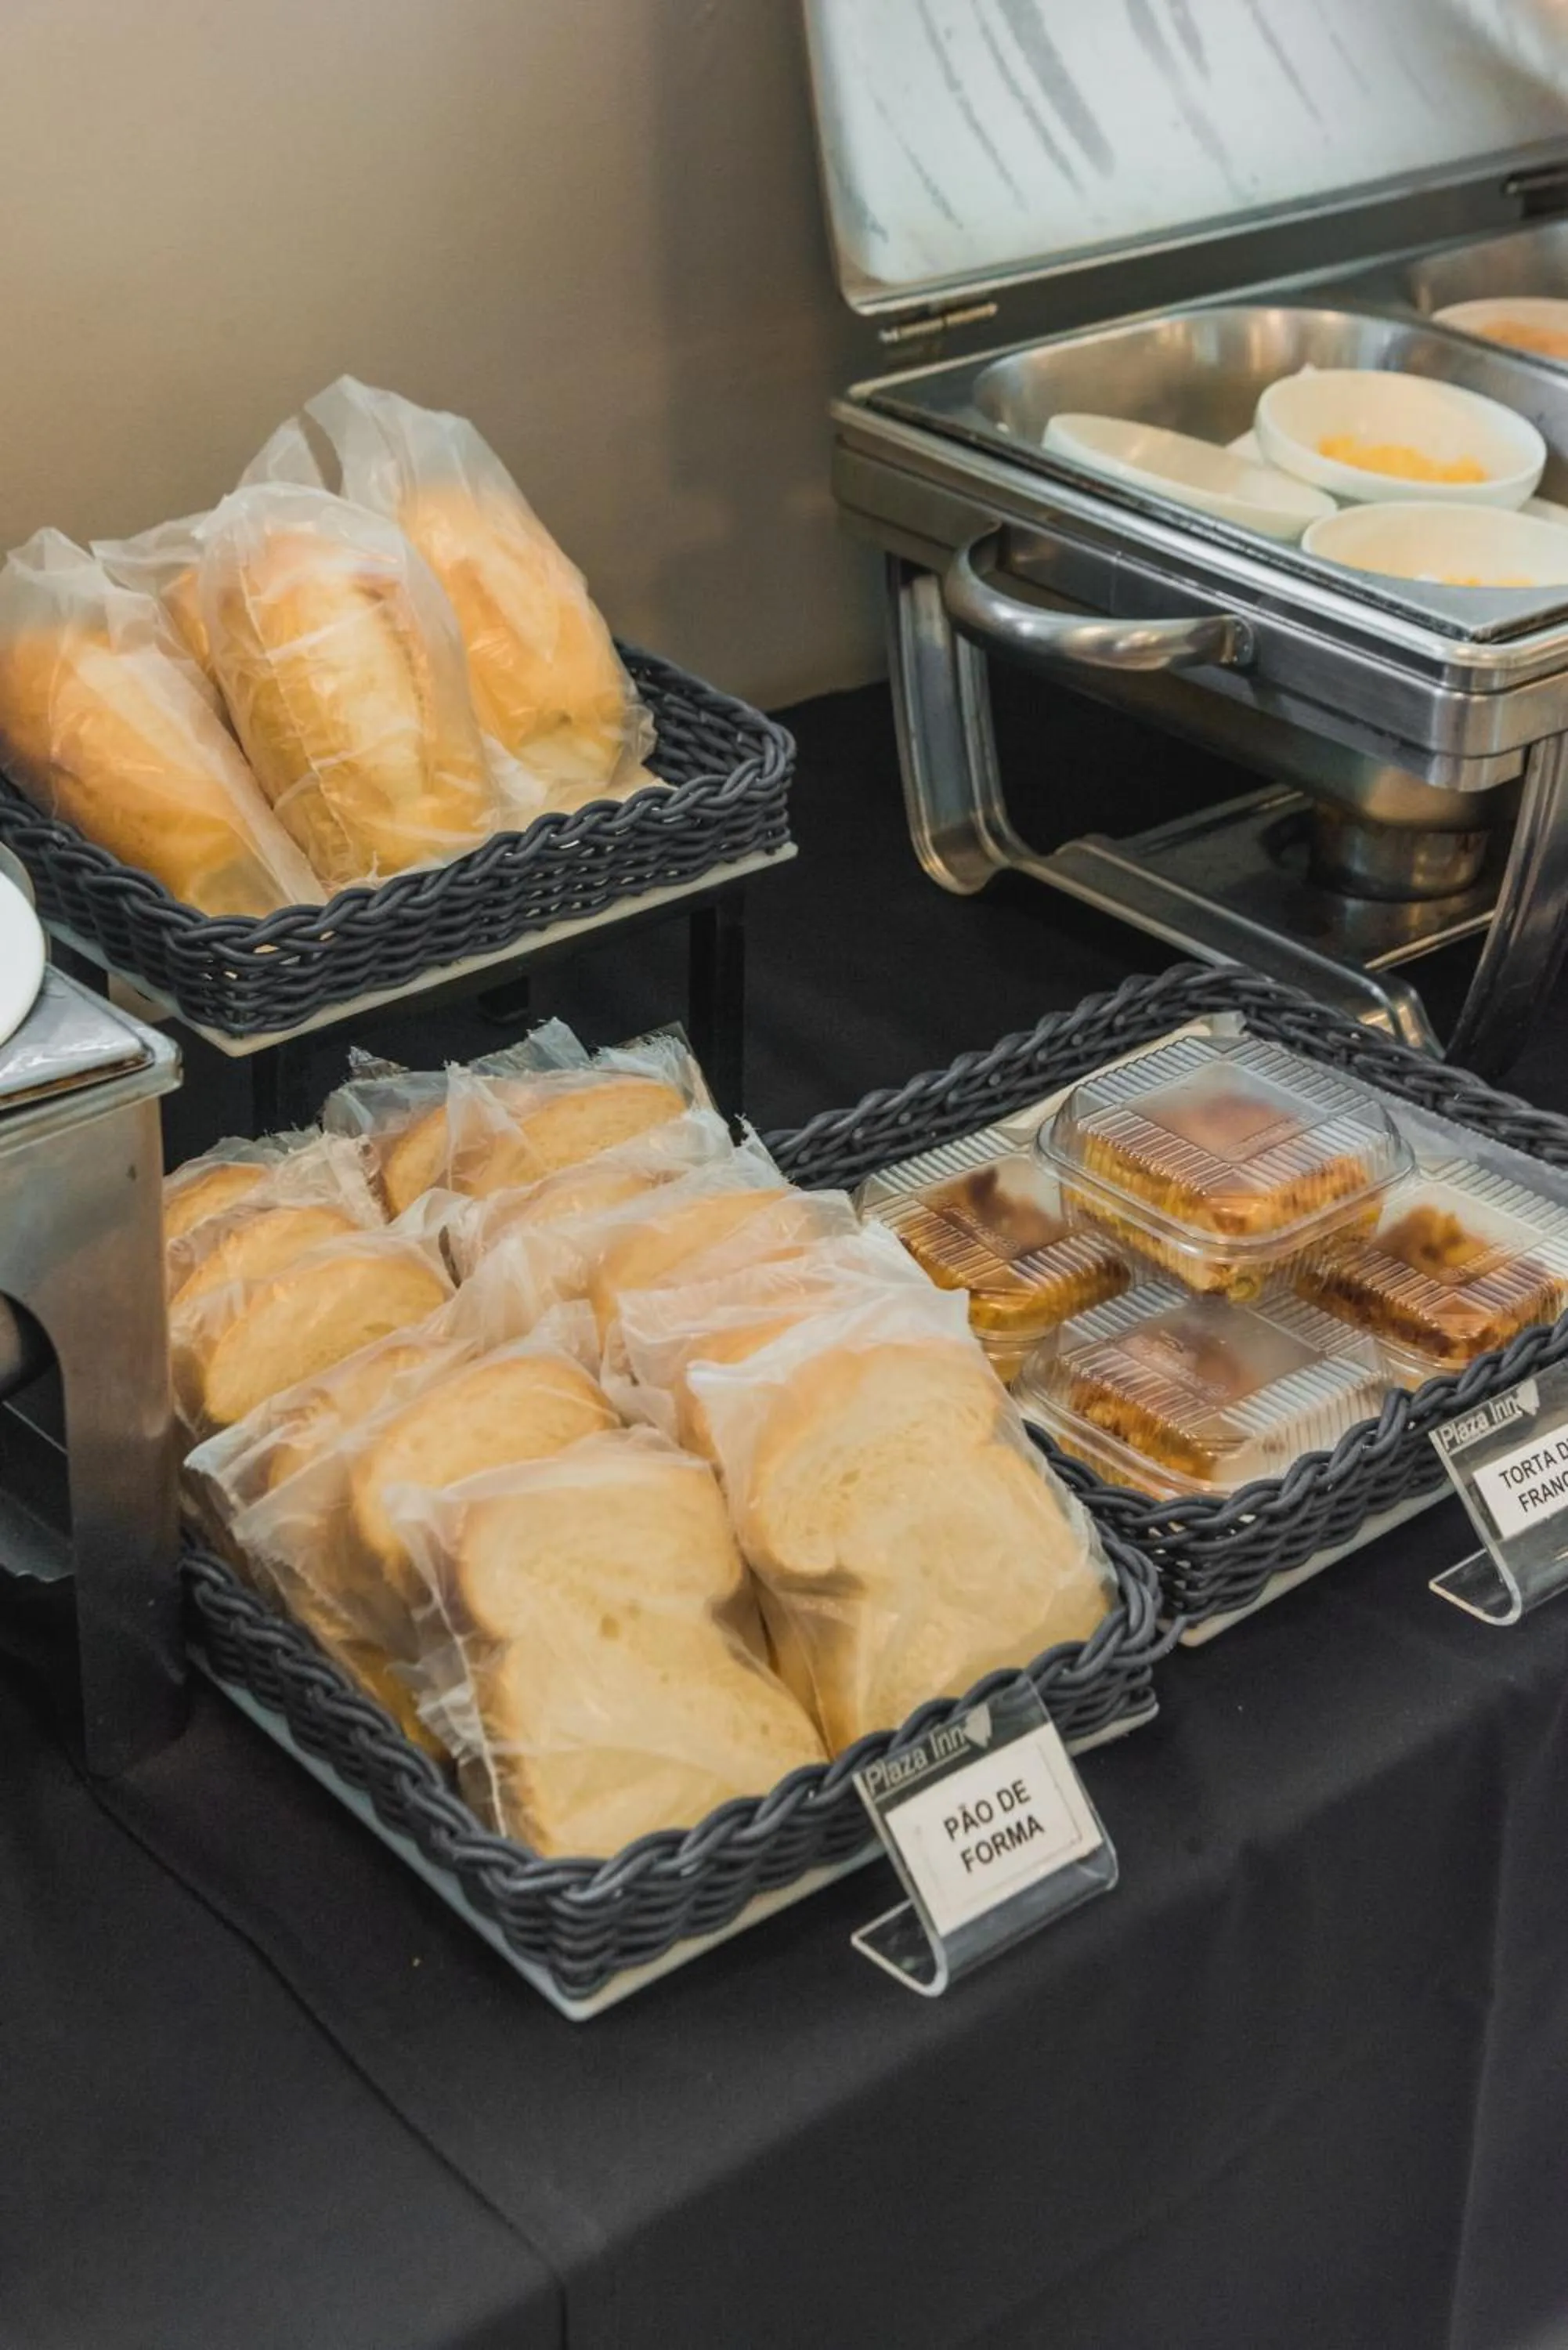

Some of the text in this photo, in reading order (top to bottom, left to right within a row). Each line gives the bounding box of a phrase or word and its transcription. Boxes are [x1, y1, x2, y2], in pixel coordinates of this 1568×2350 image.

[1441, 1395, 1519, 1451] Plaza Inn
[1498, 1437, 1568, 1489] TORTA D
[865, 1725, 966, 1796] Plaza Inn
[943, 1779, 1031, 1841] PÃO DE
[960, 1814, 1045, 1874] FORMA
